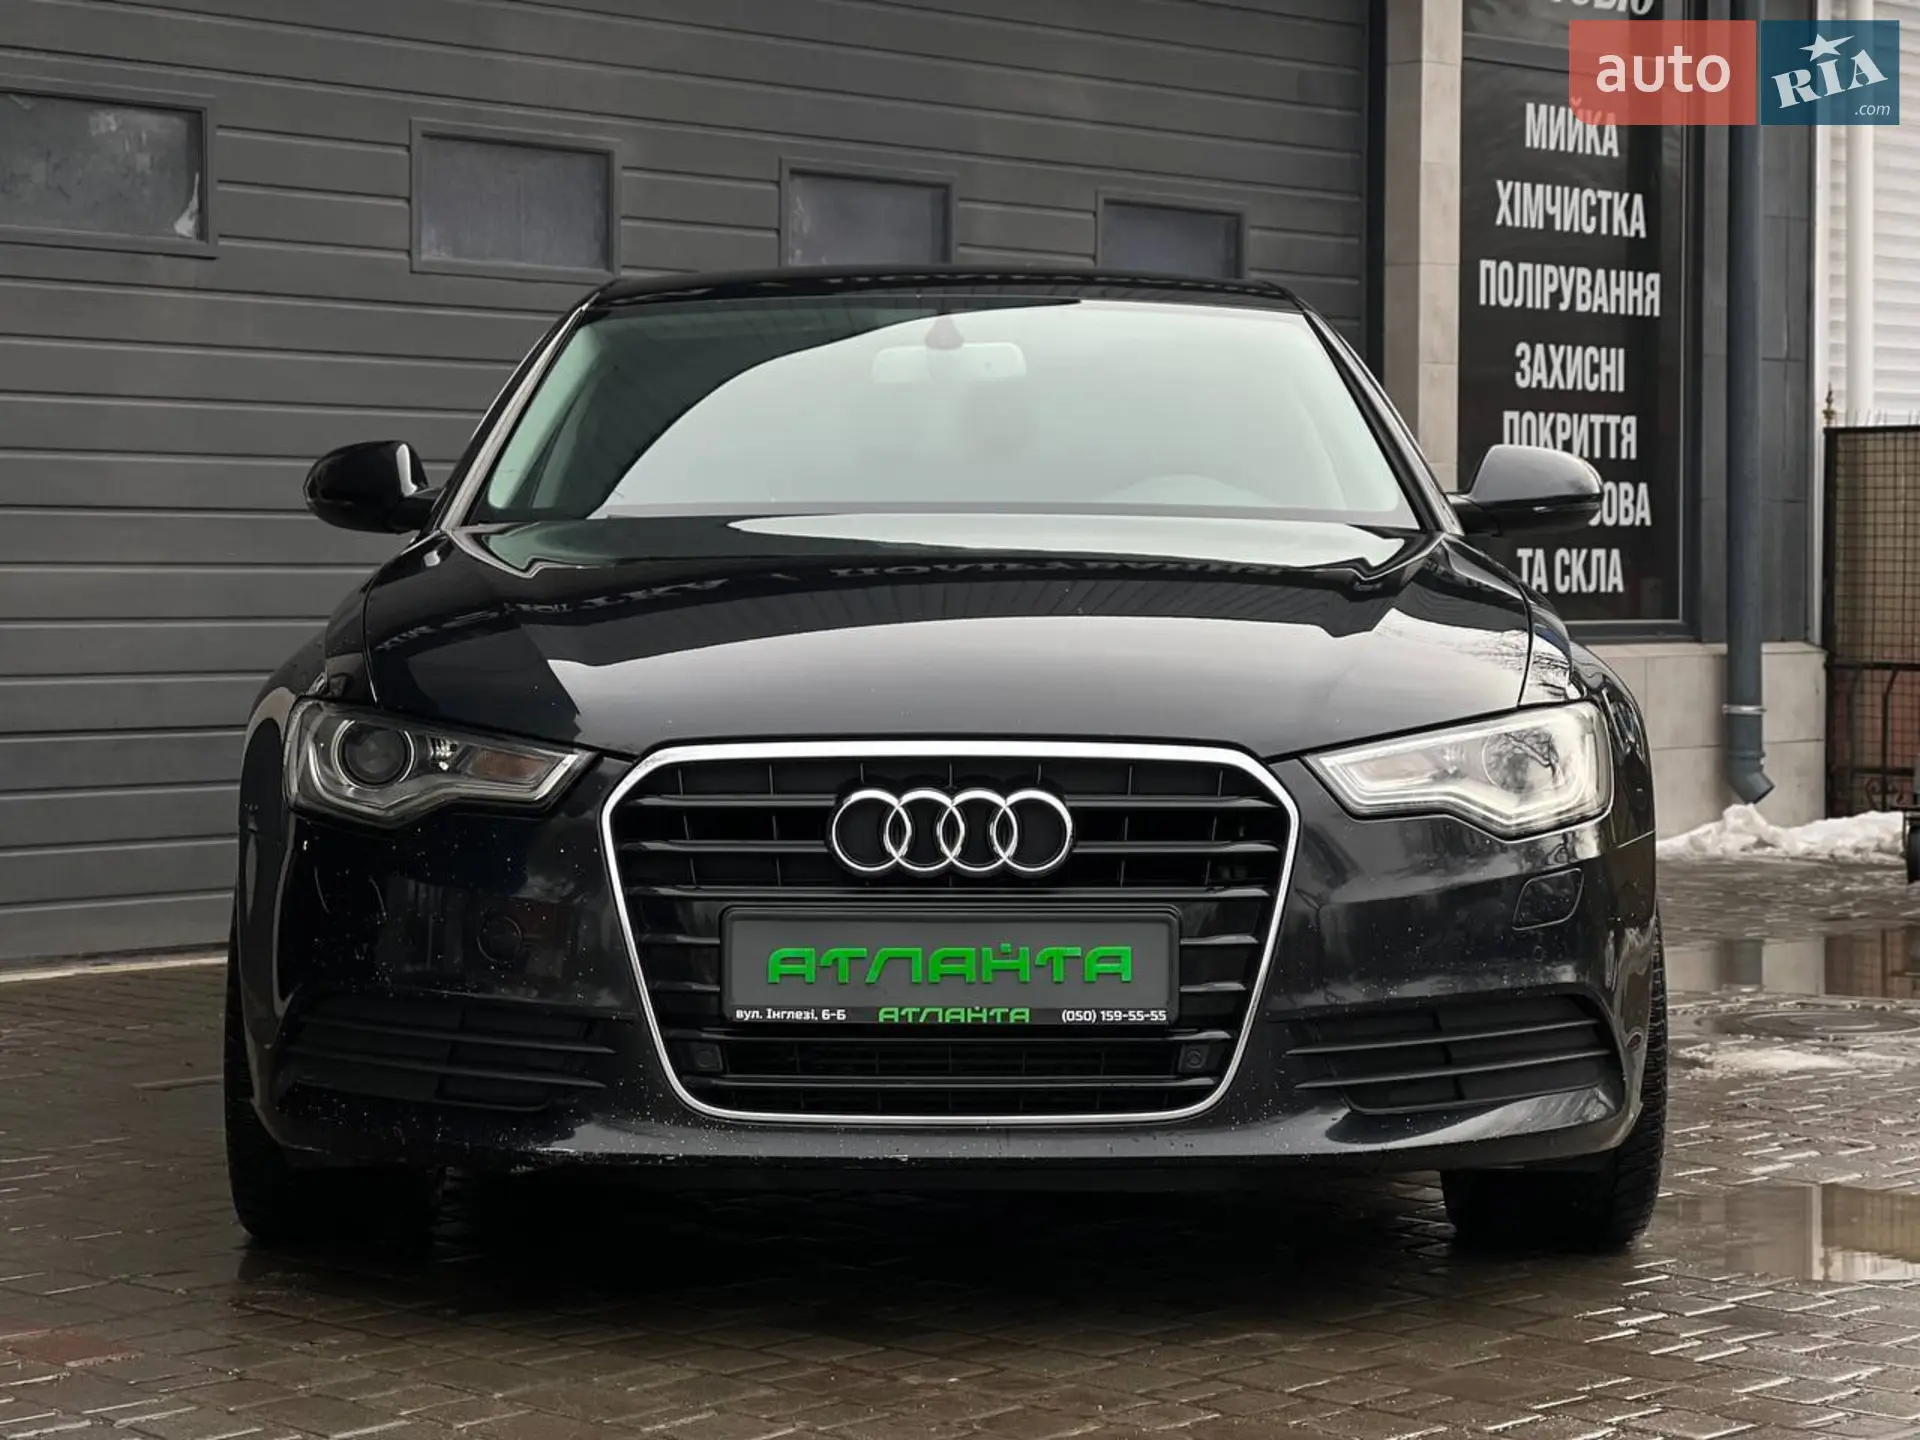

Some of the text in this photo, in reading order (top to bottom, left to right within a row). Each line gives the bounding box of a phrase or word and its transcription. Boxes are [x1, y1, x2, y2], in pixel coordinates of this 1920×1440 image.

[1525, 97, 1619, 158] МИЙКА
[1495, 179, 1646, 239] ХІМЧИСТКА
[1479, 259, 1661, 317] ПОЛІРУВАННЯ
[1515, 342, 1625, 392] ЗАХИСНІ
[1503, 410, 1637, 460] ПОКРИТТЯ
[1588, 482, 1652, 526] ОВА
[1516, 548, 1624, 593] ТА СКЛА
[735, 1009, 763, 1021] вул.
[1061, 1009, 1167, 1024] (050) 159-55-55
